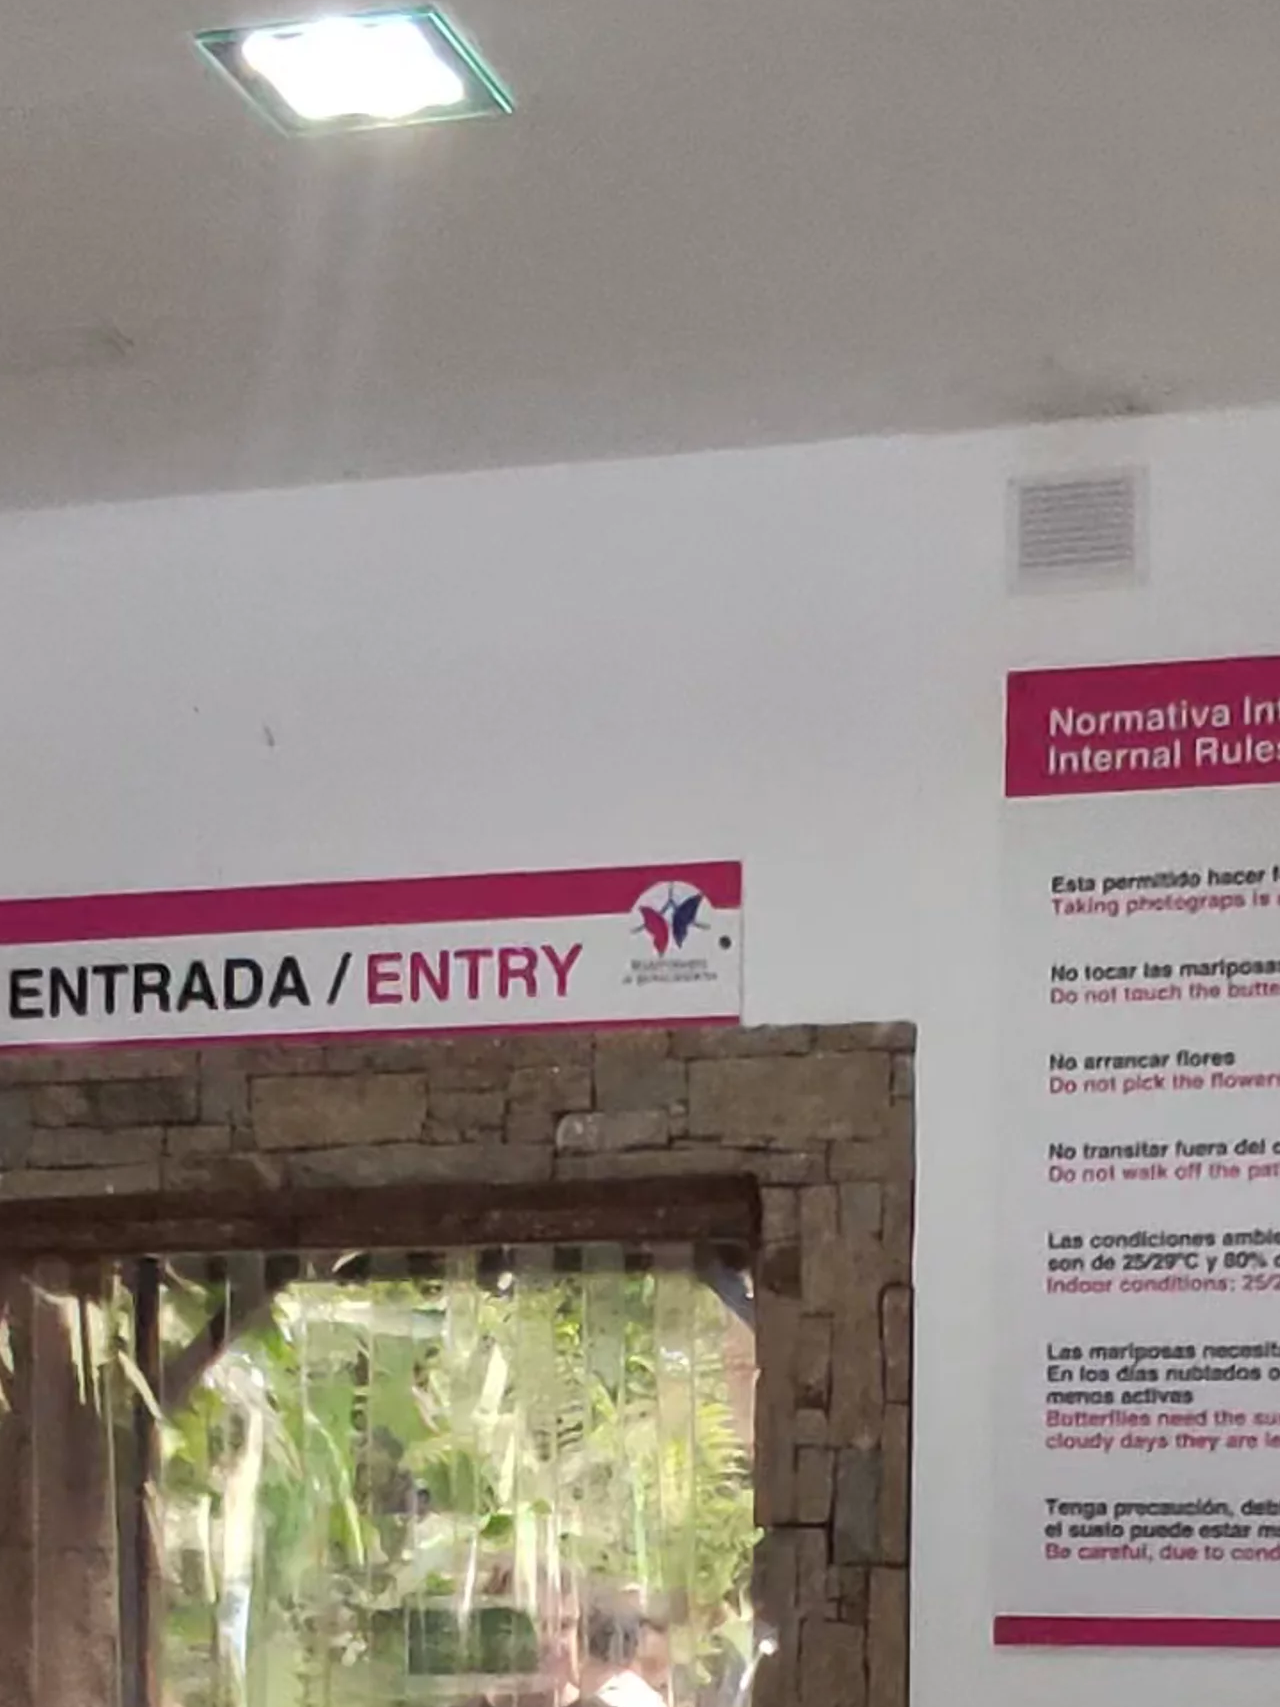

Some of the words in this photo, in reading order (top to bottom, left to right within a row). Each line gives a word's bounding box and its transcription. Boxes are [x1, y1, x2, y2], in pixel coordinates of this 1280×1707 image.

[1049, 699, 1231, 737] Normativa
[1048, 738, 1181, 775] Internal
[1051, 875, 1096, 895] Esta
[1102, 870, 1202, 894] permitido
[1207, 868, 1266, 887] hacer
[1051, 896, 1120, 917] Taking
[1251, 889, 1271, 907] is
[8, 955, 311, 1020] ENTRADA
[326, 951, 353, 1006] /
[366, 943, 583, 1005] ENTRY
[1050, 964, 1079, 983] No
[1084, 965, 1138, 982] tocar
[1142, 961, 1174, 980] las
[1049, 986, 1079, 1005] Do
[1083, 986, 1118, 1004] not
[1123, 983, 1183, 1003] touch
[1188, 982, 1222, 1000] the
[1049, 1053, 1078, 1071] No
[1083, 1053, 1171, 1071] arrancar
[1175, 1049, 1236, 1068] flores
[1049, 1075, 1078, 1095] Do
[1082, 1076, 1117, 1093] not
[1122, 1073, 1166, 1095] pick
[1171, 1073, 1205, 1091] the
[1048, 1142, 1077, 1161] No
[1082, 1141, 1170, 1160] transitar
[1174, 1139, 1228, 1158] fuera
[1233, 1137, 1266, 1156] del
[1048, 1164, 1077, 1184] Do
[1081, 1164, 1116, 1183] not
[1121, 1163, 1168, 1181] walk
[1173, 1161, 1203, 1181] off
[1207, 1161, 1242, 1180] the
[1047, 1232, 1084, 1250] Las
[1089, 1230, 1217, 1250] condiciones
[1047, 1256, 1086, 1273] son
[1090, 1253, 1117, 1271] de
[1205, 1255, 1219, 1273] y
[1046, 1275, 1113, 1294] Indoor
[1046, 1342, 1084, 1361] Las
[1088, 1342, 1197, 1364] mariposas
[1046, 1364, 1074, 1383] En
[1079, 1364, 1110, 1383] los
[1165, 1363, 1262, 1382] nublados
[1045, 1390, 1115, 1406] menos
[1120, 1387, 1195, 1405] activas
[1045, 1409, 1152, 1428] Butterflies
[1156, 1409, 1208, 1427] need
[1213, 1409, 1247, 1427] the
[1045, 1432, 1116, 1454] cloudy
[1119, 1431, 1170, 1453] days
[1174, 1432, 1221, 1452] they
[1224, 1434, 1259, 1450] are
[1044, 1497, 1108, 1520] Tenga
[1044, 1520, 1063, 1539] el
[1129, 1521, 1195, 1542] puede
[1198, 1522, 1253, 1540] estar
[1044, 1543, 1073, 1561] Be
[1158, 1544, 1199, 1561] due
[1203, 1544, 1226, 1562] to
